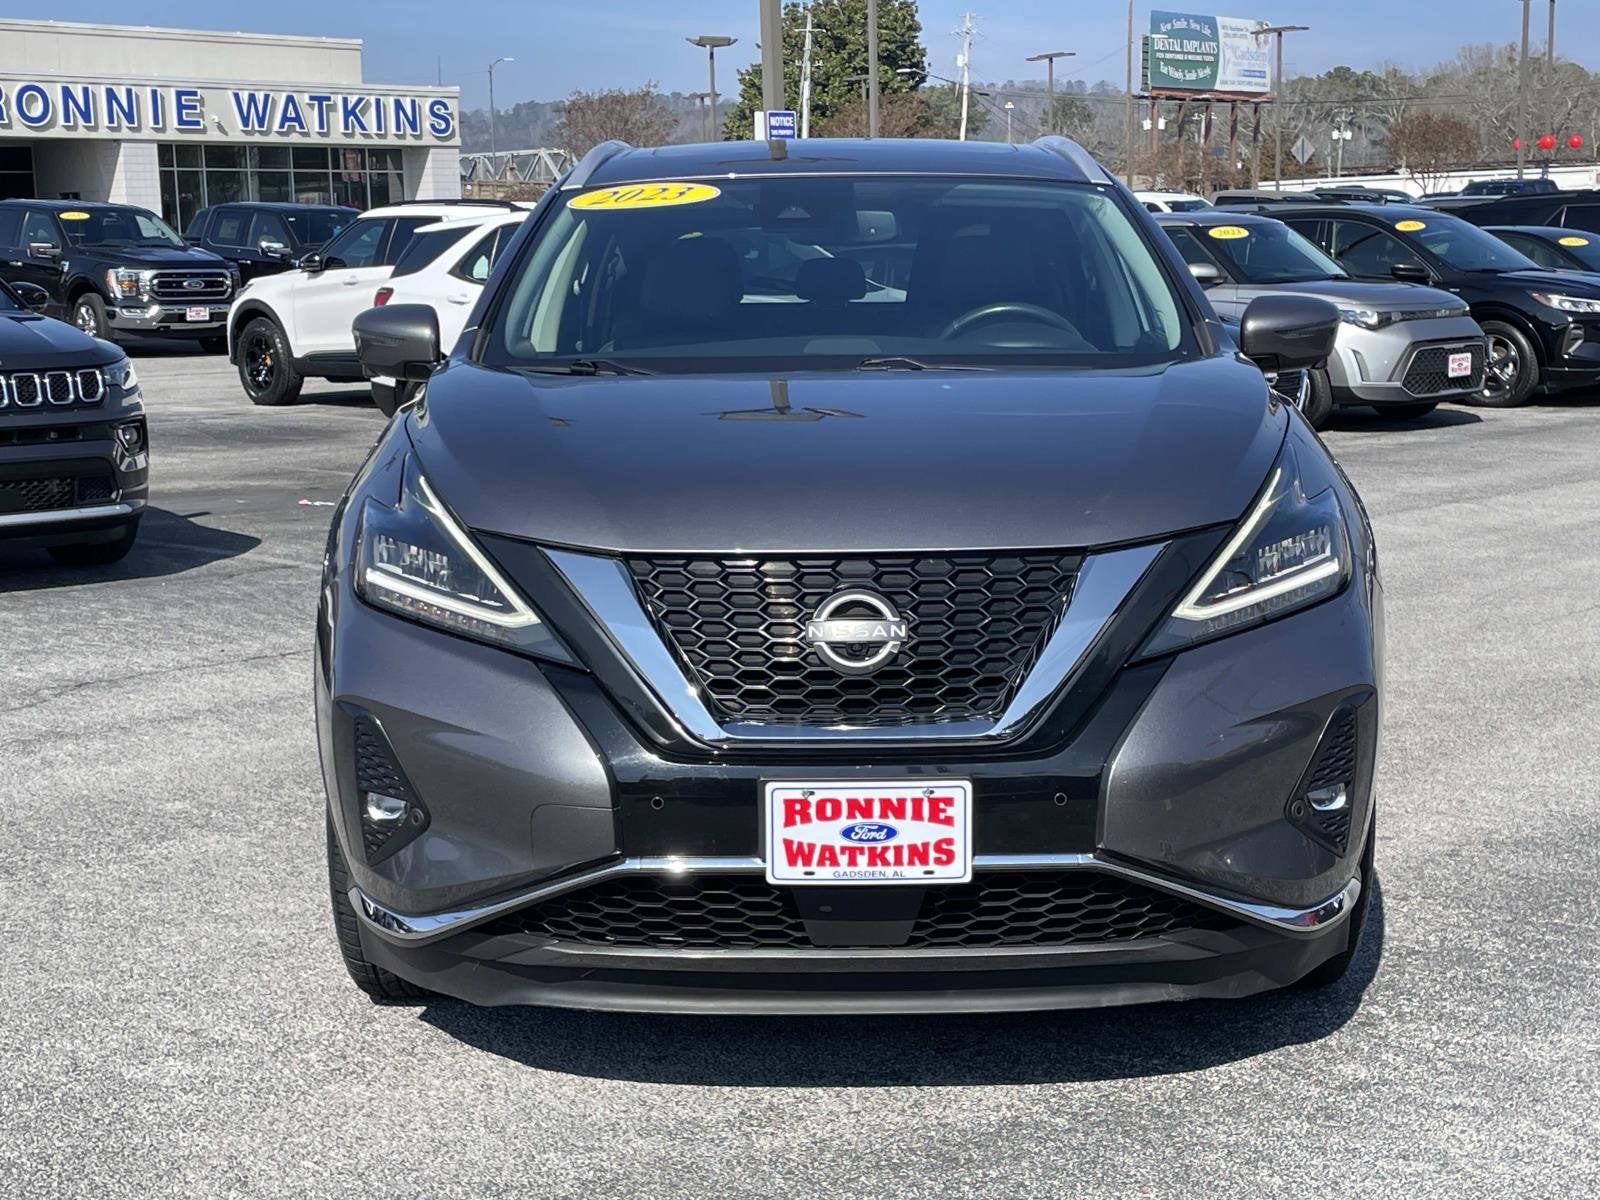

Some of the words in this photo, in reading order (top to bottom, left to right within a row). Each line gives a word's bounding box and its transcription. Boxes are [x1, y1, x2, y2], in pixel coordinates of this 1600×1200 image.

[1154, 38, 1182, 52] DENTAL
[1183, 39, 1218, 54] IMPLANTS
[0, 82, 205, 130] ONNIE
[231, 90, 455, 138] WATKINS
[769, 116, 794, 127] NOTICE
[586, 185, 695, 206] 2023
[807, 623, 907, 639] NISSAN
[782, 796, 955, 829] RONNIE
[850, 823, 887, 842] Ford
[782, 837, 956, 868] WATKINS
[832, 869, 890, 879] GADSDEN,
[892, 869, 907, 879] AL
